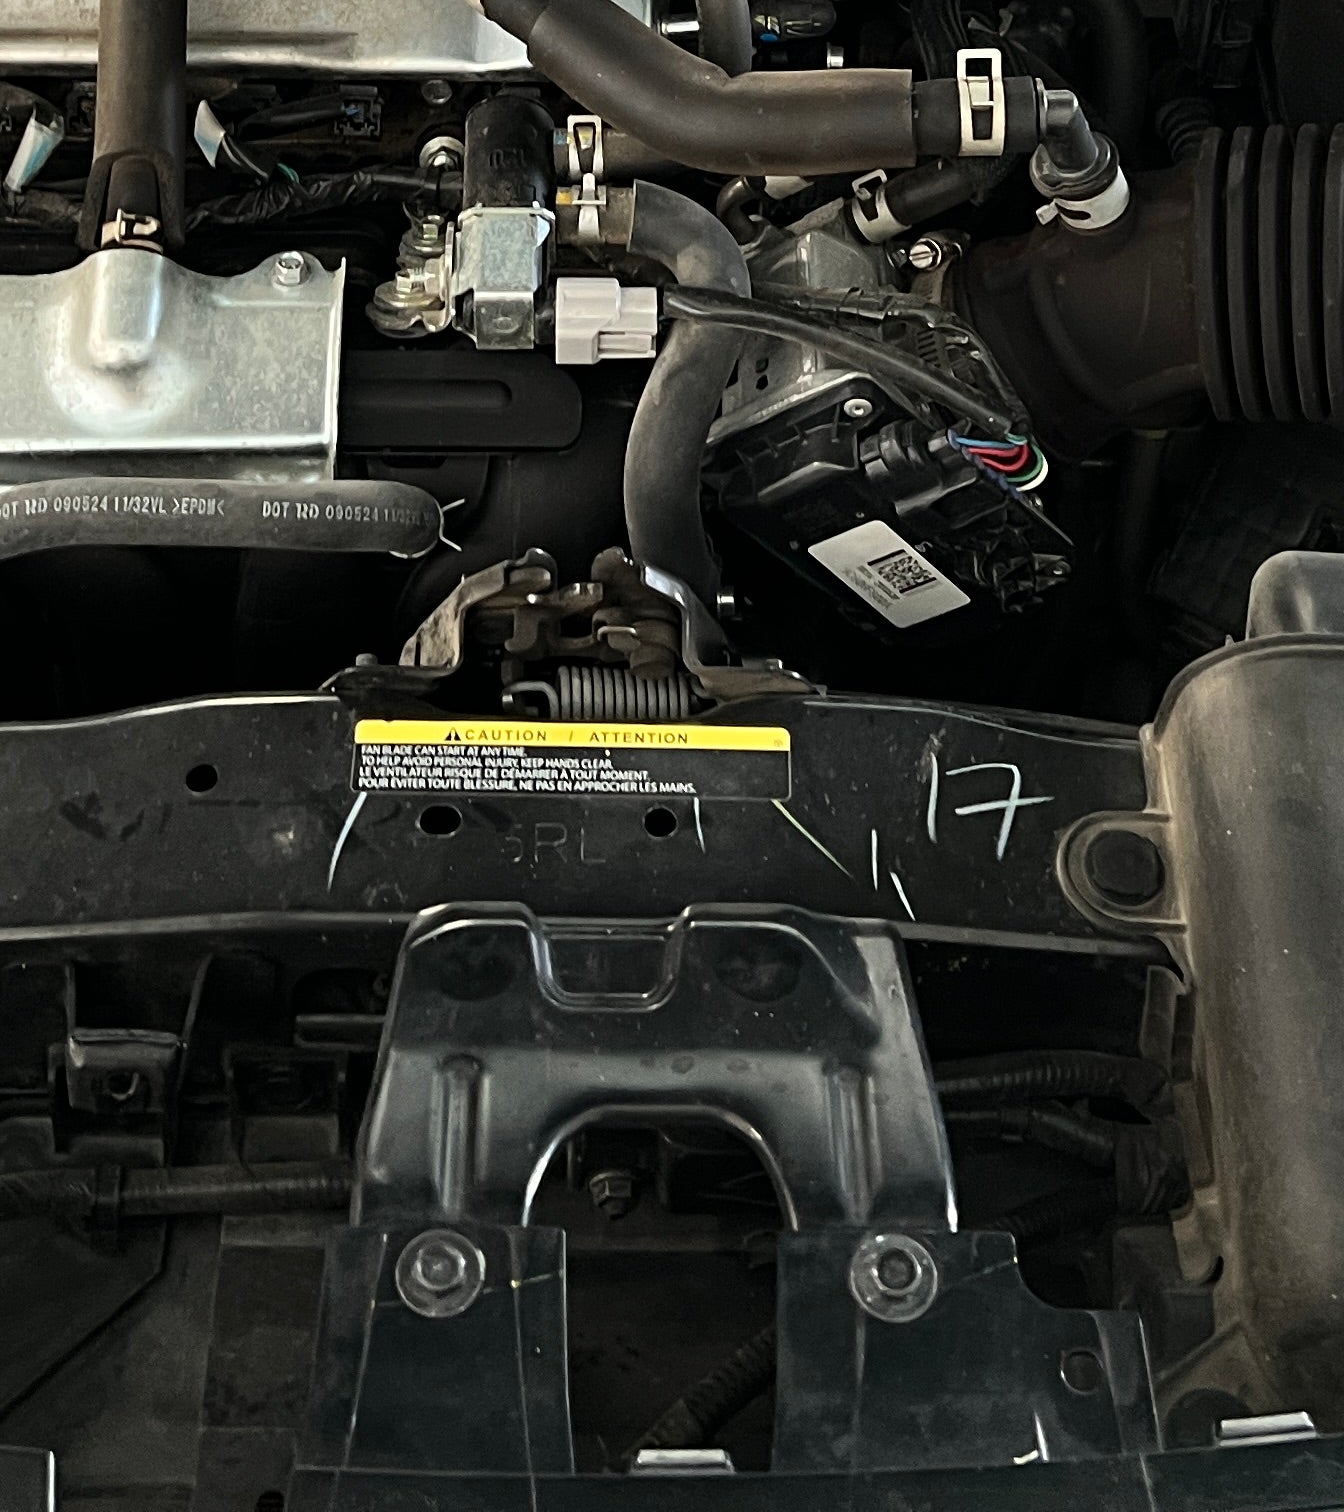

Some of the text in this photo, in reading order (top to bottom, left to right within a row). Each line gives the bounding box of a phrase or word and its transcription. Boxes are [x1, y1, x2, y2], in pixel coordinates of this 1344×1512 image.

[54, 495, 108, 513] 090524
[262, 500, 290, 519] DOT
[465, 729, 547, 742] CAUTION
[589, 731, 688, 744] ATTENTION
[361, 745, 381, 756] FAN
[382, 745, 413, 756] BLADE
[415, 745, 436, 756] CAN
[437, 745, 467, 756] START
[467, 746, 479, 756] AT
[481, 746, 501, 757] ANY
[362, 755, 375, 766] TO
[376, 755, 401, 766] HELP
[401, 755, 433, 767] AVOID
[433, 755, 483, 768] PERSONAL
[520, 757, 544, 769] KEEP
[545, 758, 580, 769] HANDS
[359, 766, 372, 777] LE
[373, 766, 443, 779] VENTILATEUR
[444, 767, 482, 780] RISQUE
[484, 768, 498, 780] DE
[570, 769, 598, 780] TOUT
[358, 777, 389, 789] POUR
[427, 778, 462, 790] TOUTE
[518, 779, 535, 791] NE
[536, 779, 556, 792] PAS
[557, 780, 572, 791] EN
[573, 780, 638, 793] APPROCHER
[639, 781, 658, 793] LES
[927, 751, 1055, 862] 17
